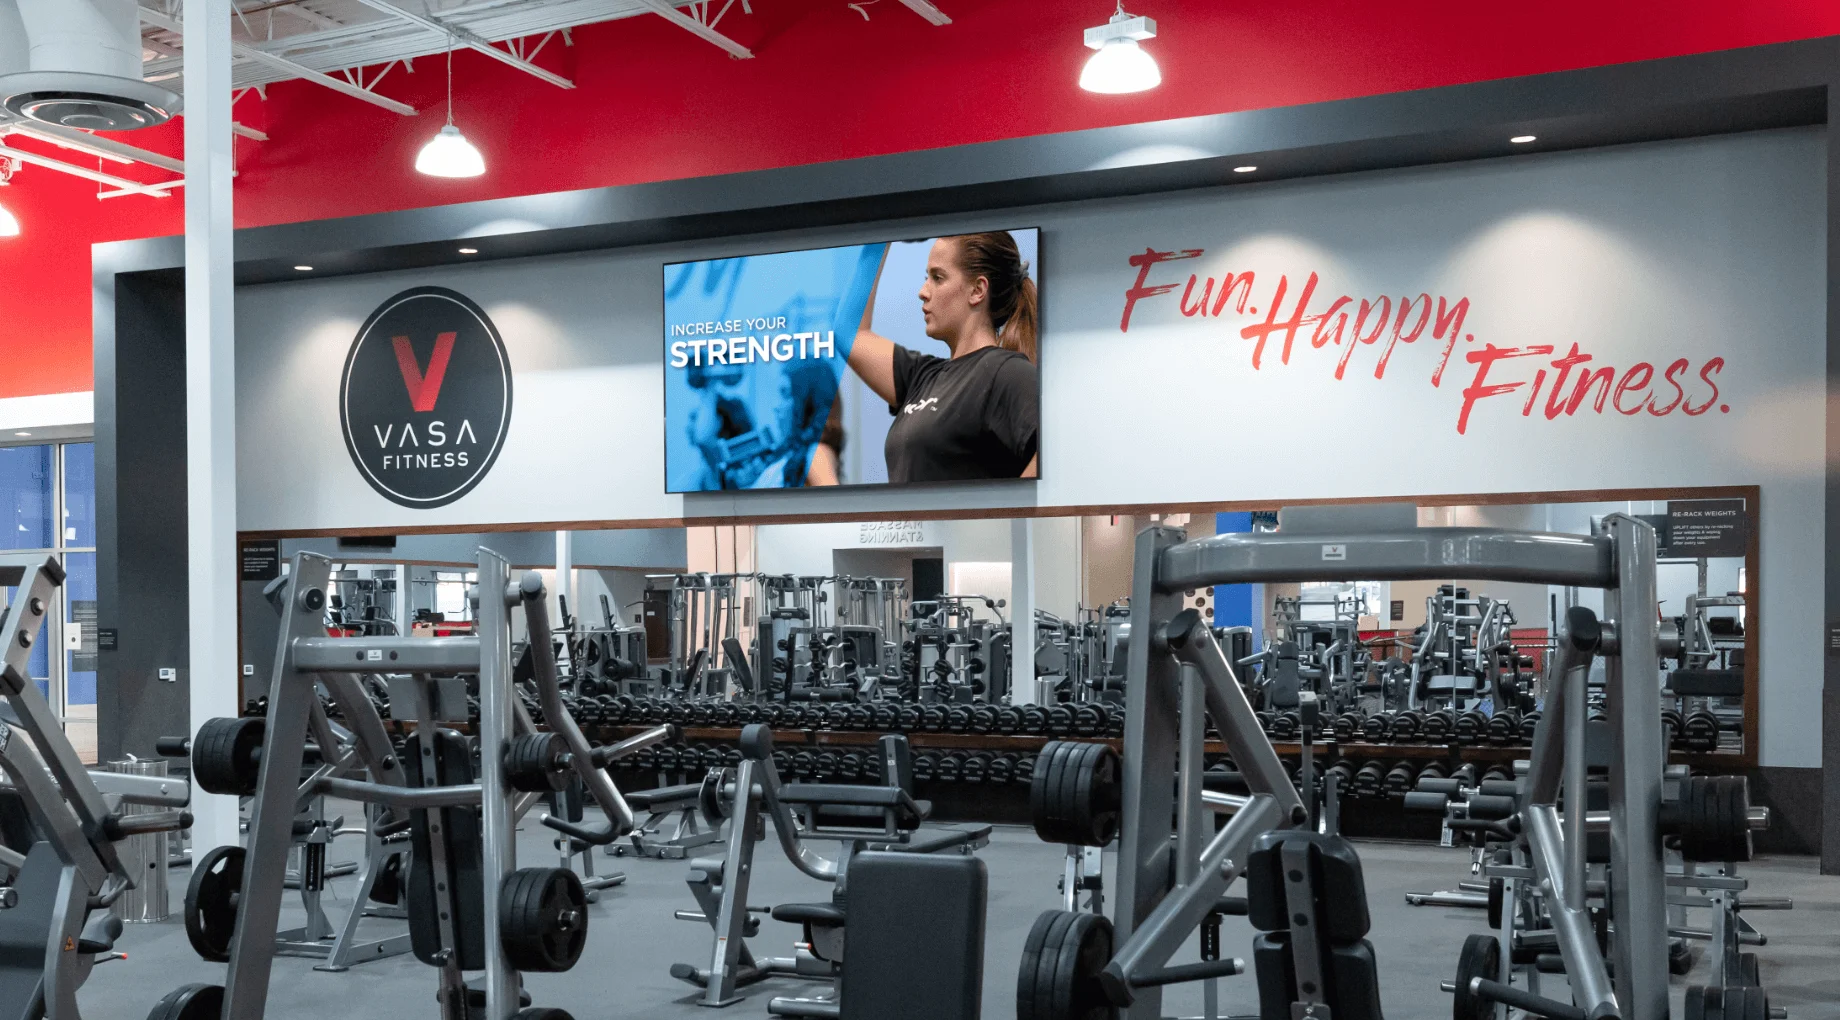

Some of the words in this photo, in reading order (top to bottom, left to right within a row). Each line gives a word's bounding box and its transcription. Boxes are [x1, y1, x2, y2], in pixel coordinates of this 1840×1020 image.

[671, 319, 742, 337] INCREASE
[746, 316, 786, 331] YOUR
[670, 330, 835, 368] STRENGTH
[1121, 248, 1258, 333] Fun.
[1240, 270, 1475, 388] Happy.
[1456, 341, 1730, 436] Fitness.
[373, 419, 477, 449] VASA
[383, 451, 469, 470] FITNESS
